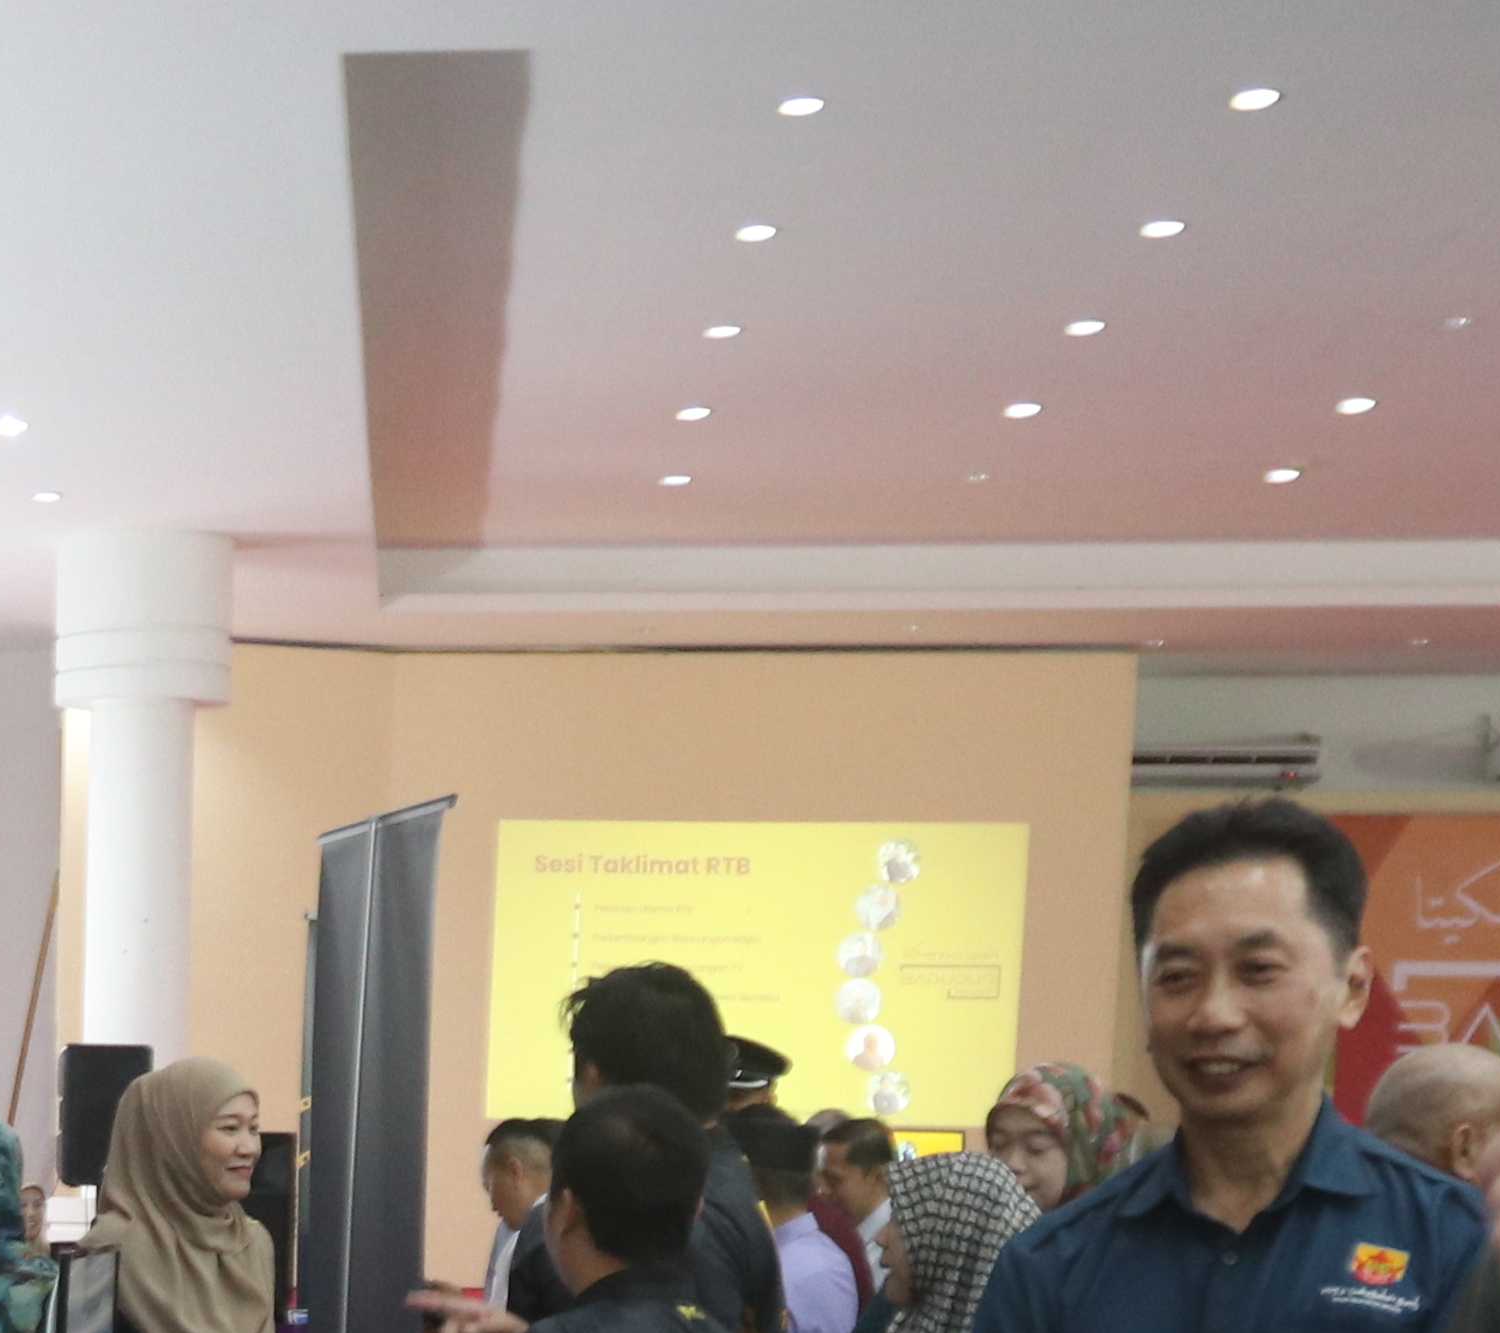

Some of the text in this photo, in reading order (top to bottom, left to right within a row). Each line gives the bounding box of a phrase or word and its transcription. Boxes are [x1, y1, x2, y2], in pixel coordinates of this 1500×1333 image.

[535, 853, 751, 876] Sesi Taklimat RTB
